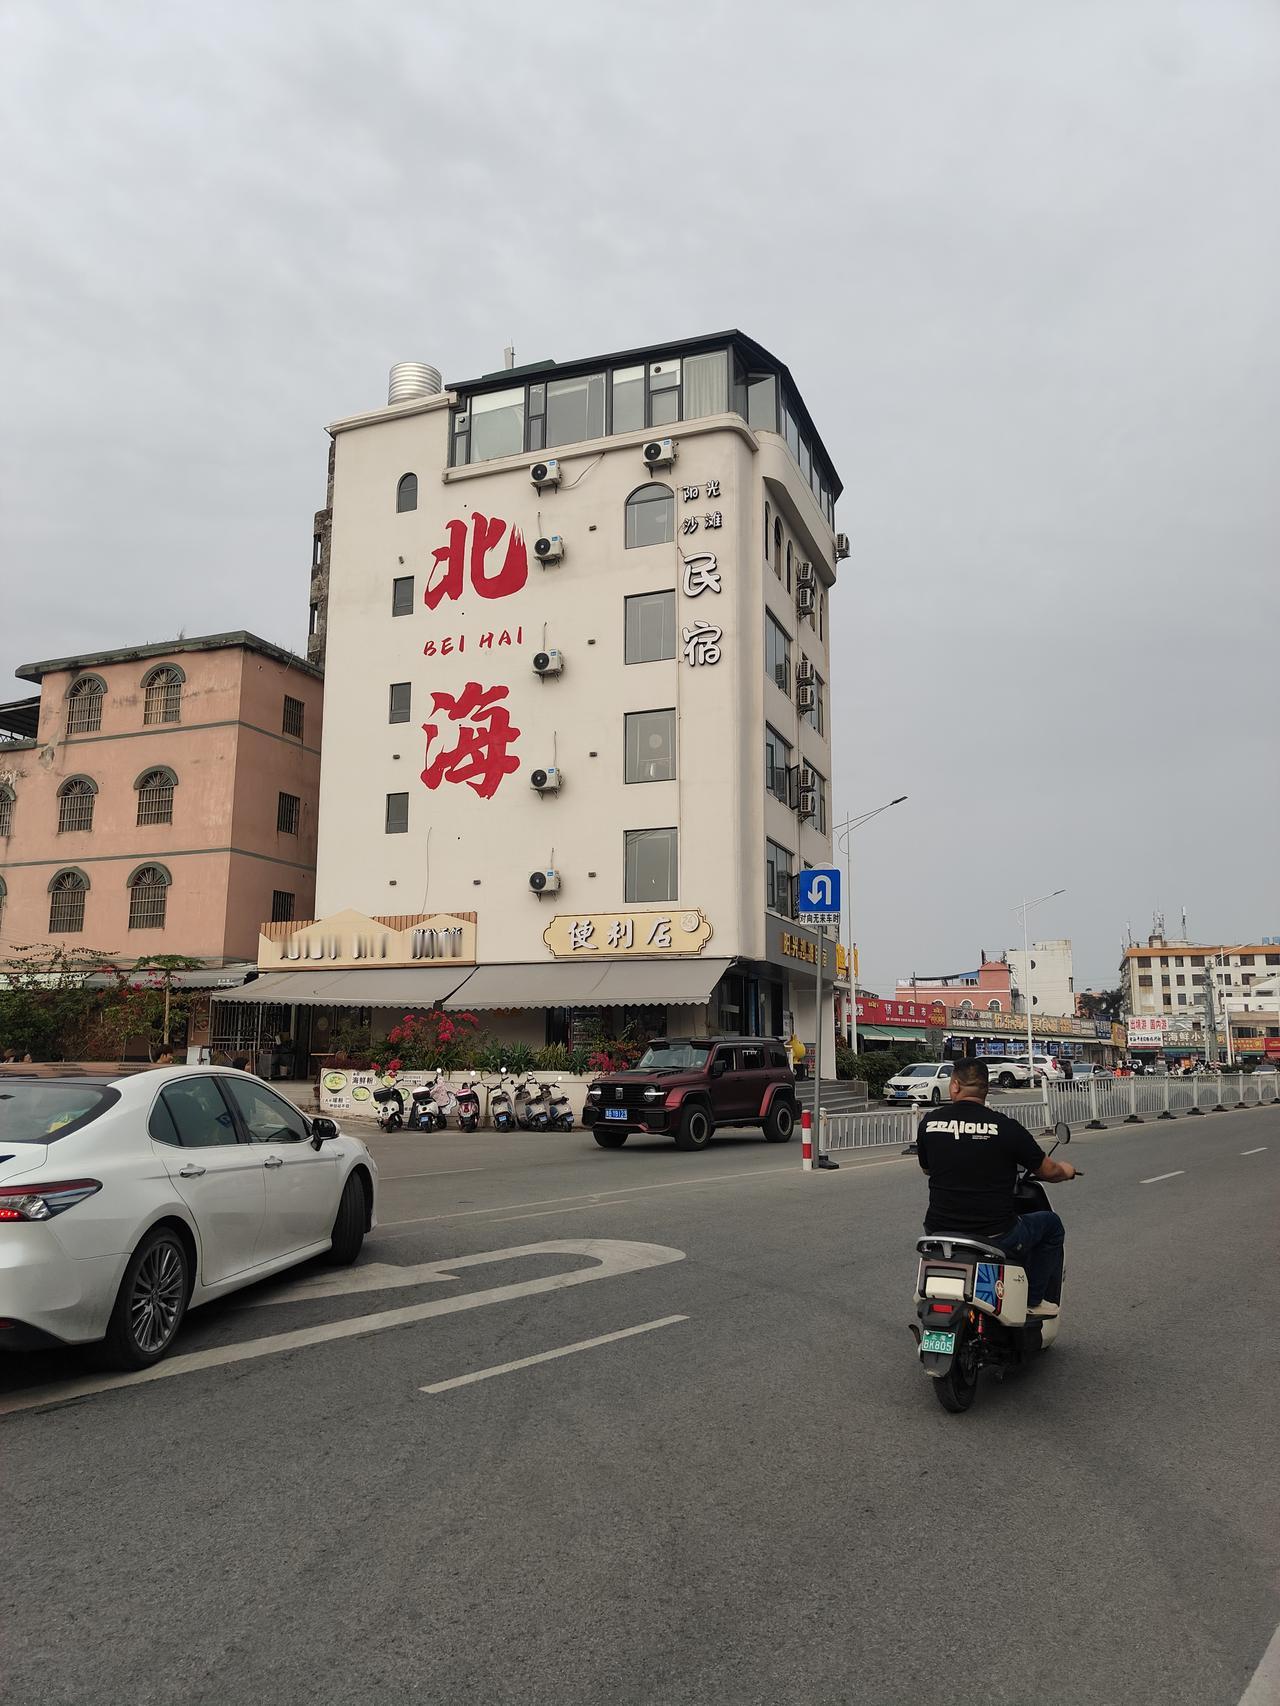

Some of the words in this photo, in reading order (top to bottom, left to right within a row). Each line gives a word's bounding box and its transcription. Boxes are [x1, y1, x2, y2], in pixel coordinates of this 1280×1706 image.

[683, 480, 720, 502] 阳光
[683, 511, 723, 534] 沙滩
[424, 511, 528, 610] 北
[682, 551, 723, 666] 民宿
[423, 634, 465, 656] BEI
[479, 626, 523, 649] HAI
[420, 681, 521, 800] 海
[800, 913, 840, 924] 对向无来车时
[568, 918, 672, 951] 便利店
[923, 1339, 953, 1352] BK805
